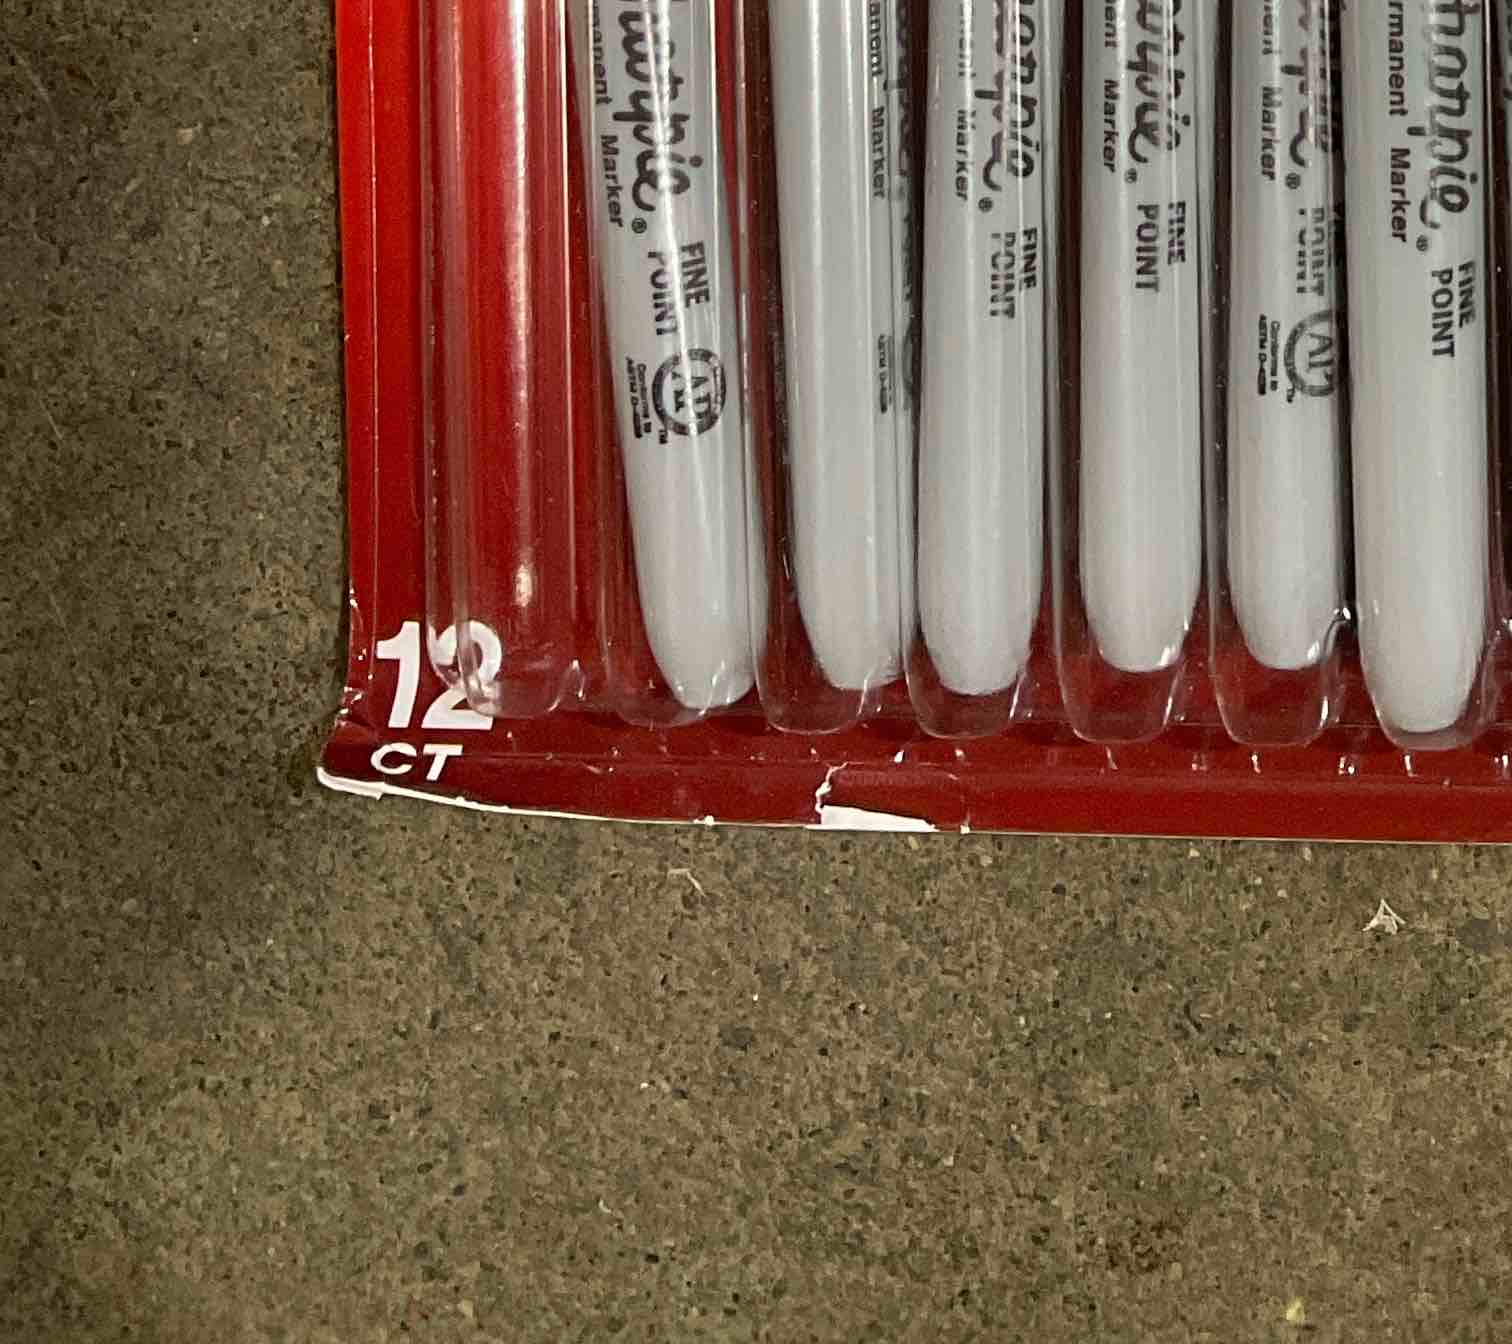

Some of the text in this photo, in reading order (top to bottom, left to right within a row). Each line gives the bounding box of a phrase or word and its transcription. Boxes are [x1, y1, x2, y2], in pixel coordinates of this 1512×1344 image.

[870, 105, 887, 200] Marker
[1101, 79, 1120, 173] Marker
[1261, 86, 1282, 182] Marker
[599, 133, 627, 228] Marker
[1389, 146, 1412, 243] Marker
[680, 240, 711, 309] FINE
[1135, 204, 1161, 294] POINT
[1457, 261, 1478, 329] FINE
[1431, 267, 1456, 358] POINT
[375, 620, 503, 731] 12
[369, 741, 464, 782] CT
